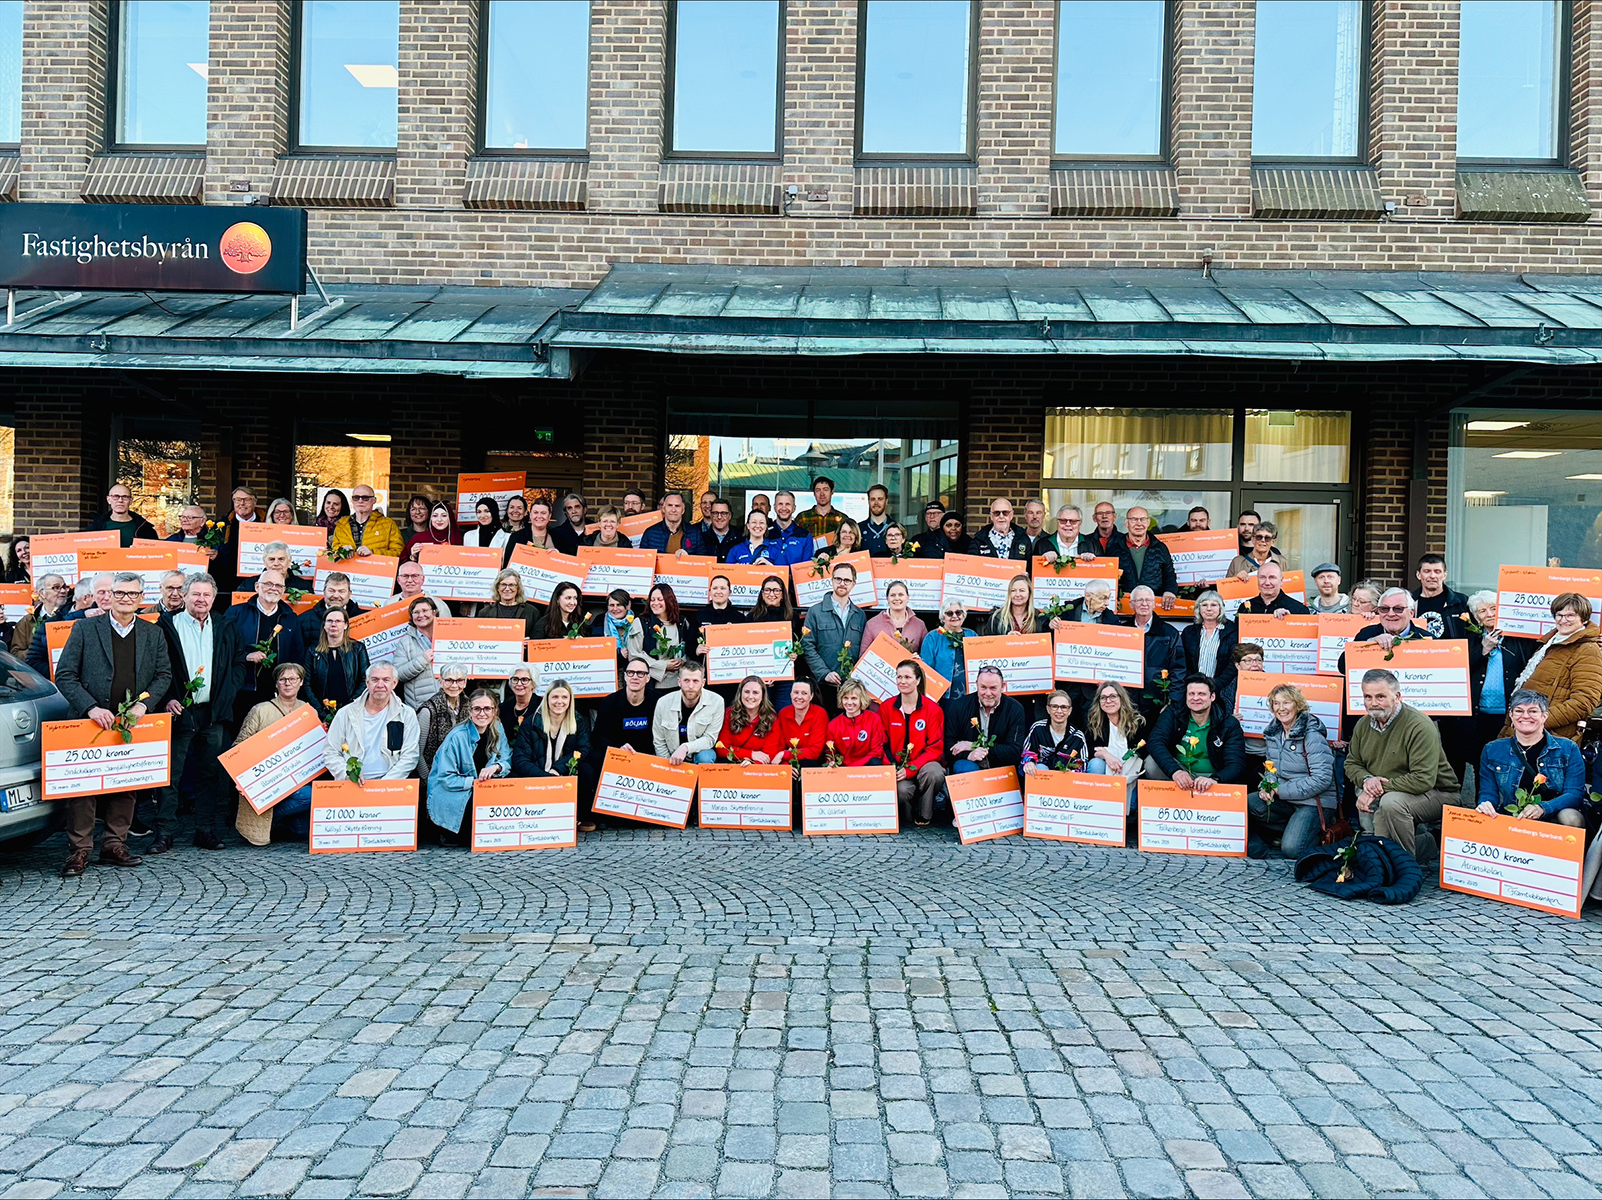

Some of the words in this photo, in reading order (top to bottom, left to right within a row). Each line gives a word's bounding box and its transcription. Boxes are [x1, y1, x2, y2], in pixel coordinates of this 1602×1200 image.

[22, 233, 209, 265] Fastighetsbyrån
[469, 493, 477, 502] 25
[44, 555, 58, 564] 100
[59, 554, 74, 562] 000
[432, 565, 443, 575] 45
[444, 566, 461, 575] 000
[519, 566, 527, 574] 50
[527, 567, 539, 577] 000
[541, 571, 558, 580] kronor
[598, 565, 610, 573] 500
[352, 574, 369, 583] kronor
[661, 575, 673, 584] 000
[956, 575, 965, 584] 25
[967, 576, 981, 586] 000
[984, 579, 1003, 588] kronor
[1046, 579, 1057, 587] 100
[1058, 579, 1071, 587] 000
[808, 581, 820, 590] 172
[1514, 593, 1525, 604] 25
[1527, 594, 1545, 605] 000
[373, 632, 387, 644] 000
[1267, 638, 1285, 648] 000
[1289, 639, 1312, 648] kronor
[448, 641, 459, 650] 30
[459, 641, 474, 649] 000
[1070, 644, 1077, 655] 15
[1078, 646, 1092, 655] 000
[1094, 648, 1113, 657] kronor
[720, 648, 731, 656] 25
[732, 648, 746, 656] 000
[544, 662, 554, 672] 87
[554, 662, 570, 671] 000
[874, 659, 885, 669] 25
[1011, 660, 1030, 668] kronor
[1404, 671, 1433, 680] kronor
[268, 726, 288, 739] Falkenbergs
[287, 717, 302, 728] Sparbank
[65, 750, 78, 762] 25
[82, 748, 102, 760] 000
[106, 748, 135, 758] kronor
[252, 765, 265, 778] 30
[264, 755, 282, 769] 000
[282, 742, 303, 758] kronor
[651, 763, 670, 771] Falkenbergs
[670, 766, 686, 774] Sparbank
[616, 775, 635, 788] 200
[637, 779, 655, 791] 000
[656, 785, 677, 796] kronor
[8, 786, 33, 805] MLJ
[713, 789, 721, 799] 70
[723, 790, 738, 799] 000
[740, 791, 761, 799] kronor
[818, 793, 830, 803] 60
[833, 793, 849, 803] 000
[852, 794, 872, 802] kronor
[965, 799, 974, 810] 57
[974, 797, 988, 808] 000
[989, 796, 1004, 805] kronor
[1038, 796, 1053, 807] 160
[1054, 798, 1070, 809] 000
[1073, 800, 1094, 811] kronor
[326, 809, 336, 820] 21
[338, 809, 355, 819] 000
[489, 807, 502, 818] 30
[503, 806, 522, 816] 000
[524, 806, 546, 815] kronor
[1158, 808, 1170, 820] 85
[1173, 809, 1193, 821] 000
[1196, 812, 1221, 822] kronor
[1508, 826, 1538, 837] Falkenbergs
[1539, 831, 1564, 840] Sparbank
[1461, 841, 1477, 854] 35
[1479, 845, 1500, 859] 000
[1504, 852, 1535, 865] kronor
